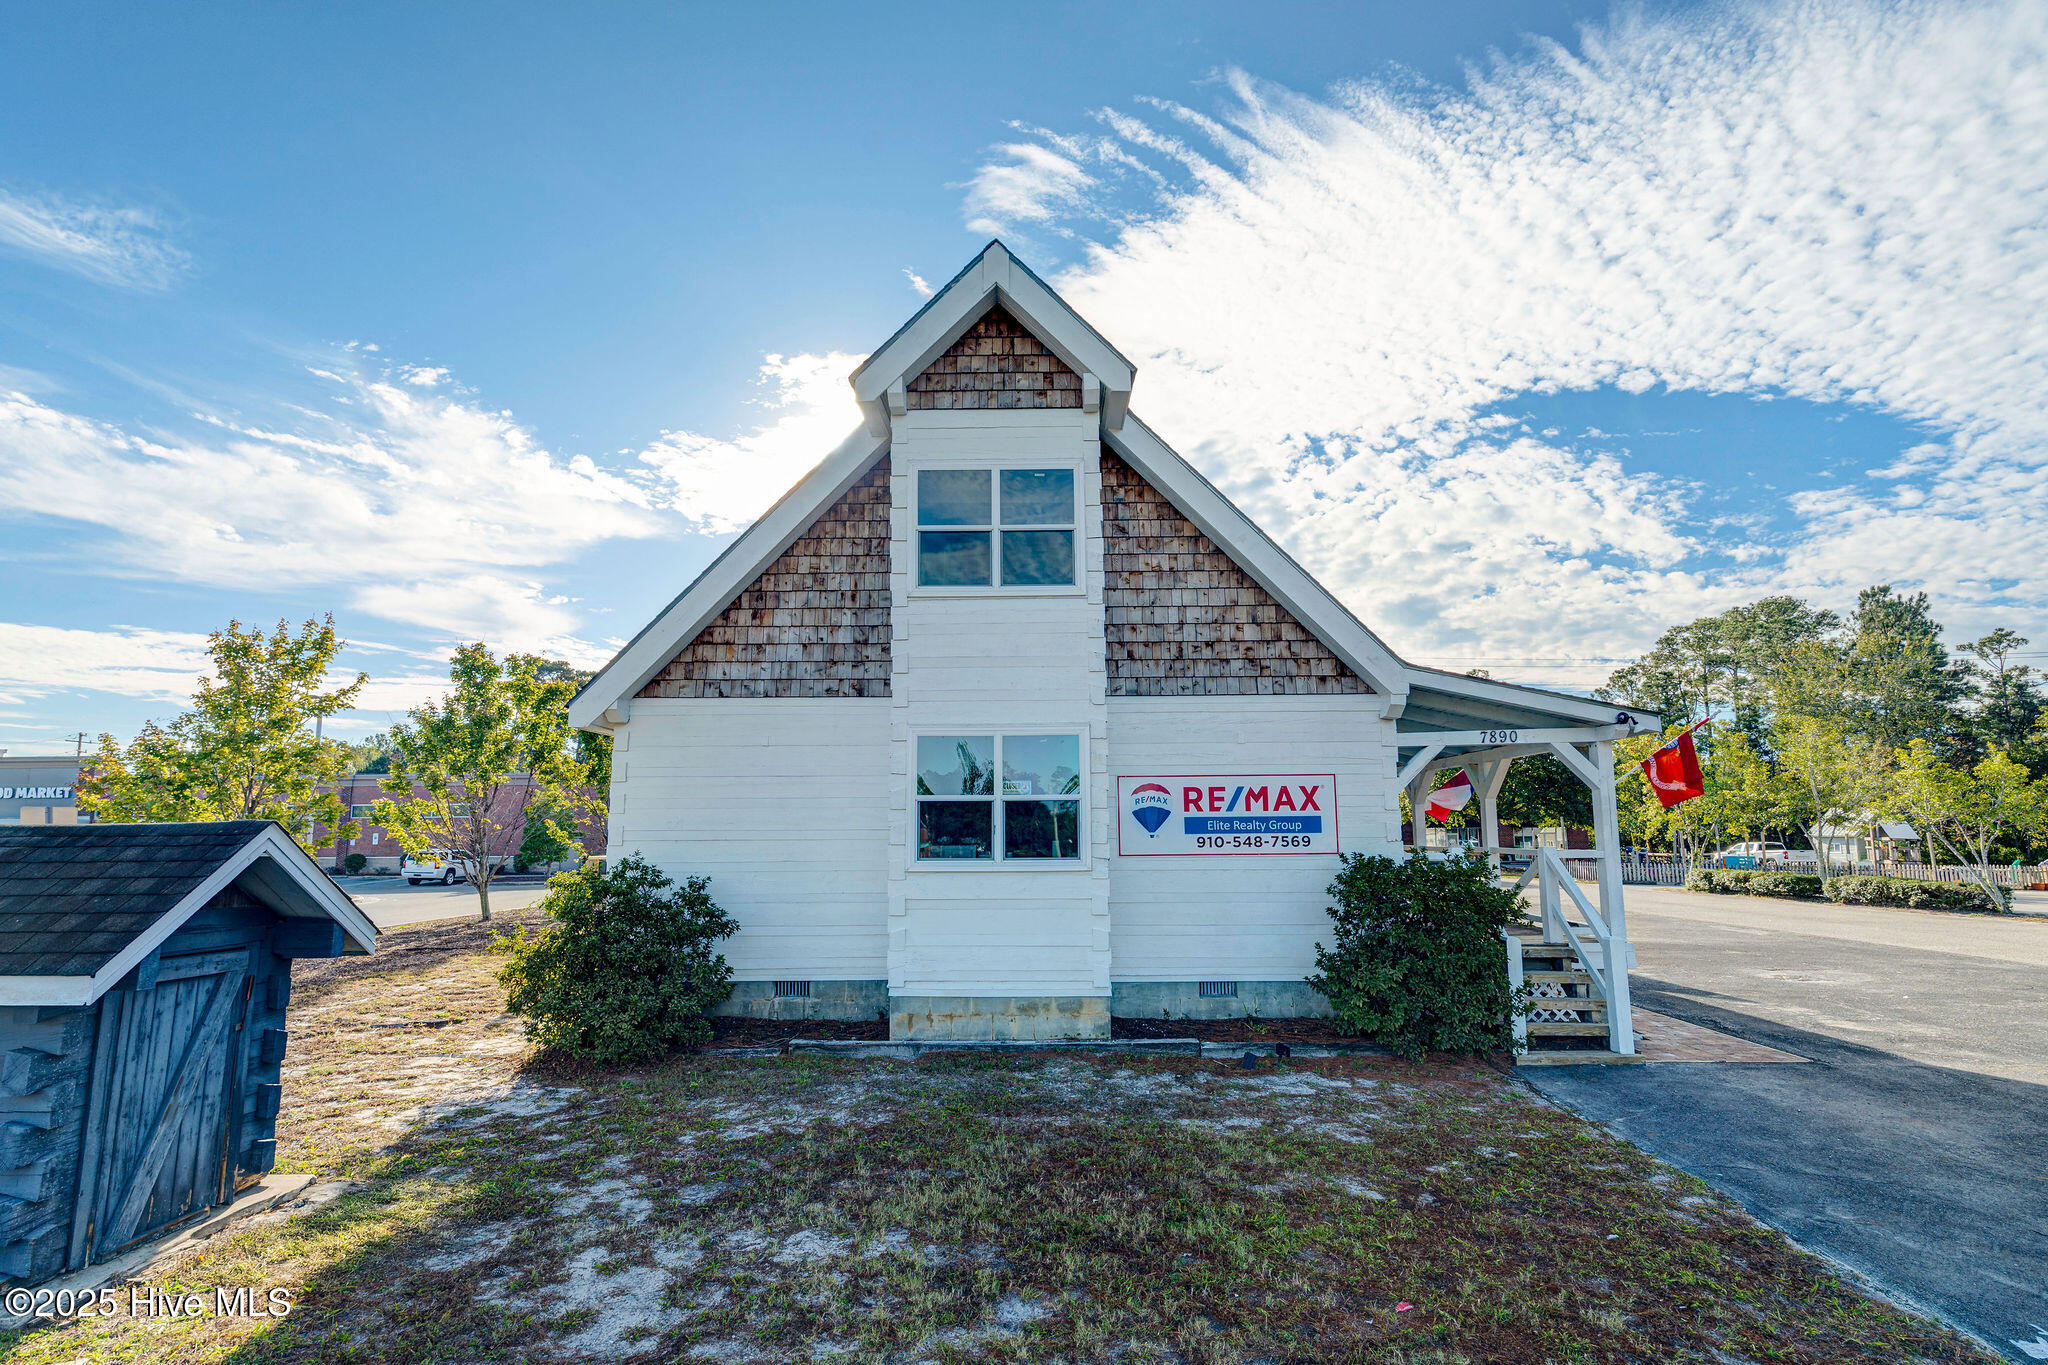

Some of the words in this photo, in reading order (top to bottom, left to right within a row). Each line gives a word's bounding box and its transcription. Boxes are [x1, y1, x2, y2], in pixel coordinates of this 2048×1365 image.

[1480, 730, 1518, 744] 7890
[15, 786, 72, 799] MARKET
[1183, 785, 1321, 812] RE/MAX
[1135, 795, 1168, 806] RE/MAX
[1207, 820, 1231, 831] Elite
[1233, 820, 1267, 832] Realty
[1268, 820, 1302, 832] Group
[1196, 835, 1312, 848] 910-548-7569
